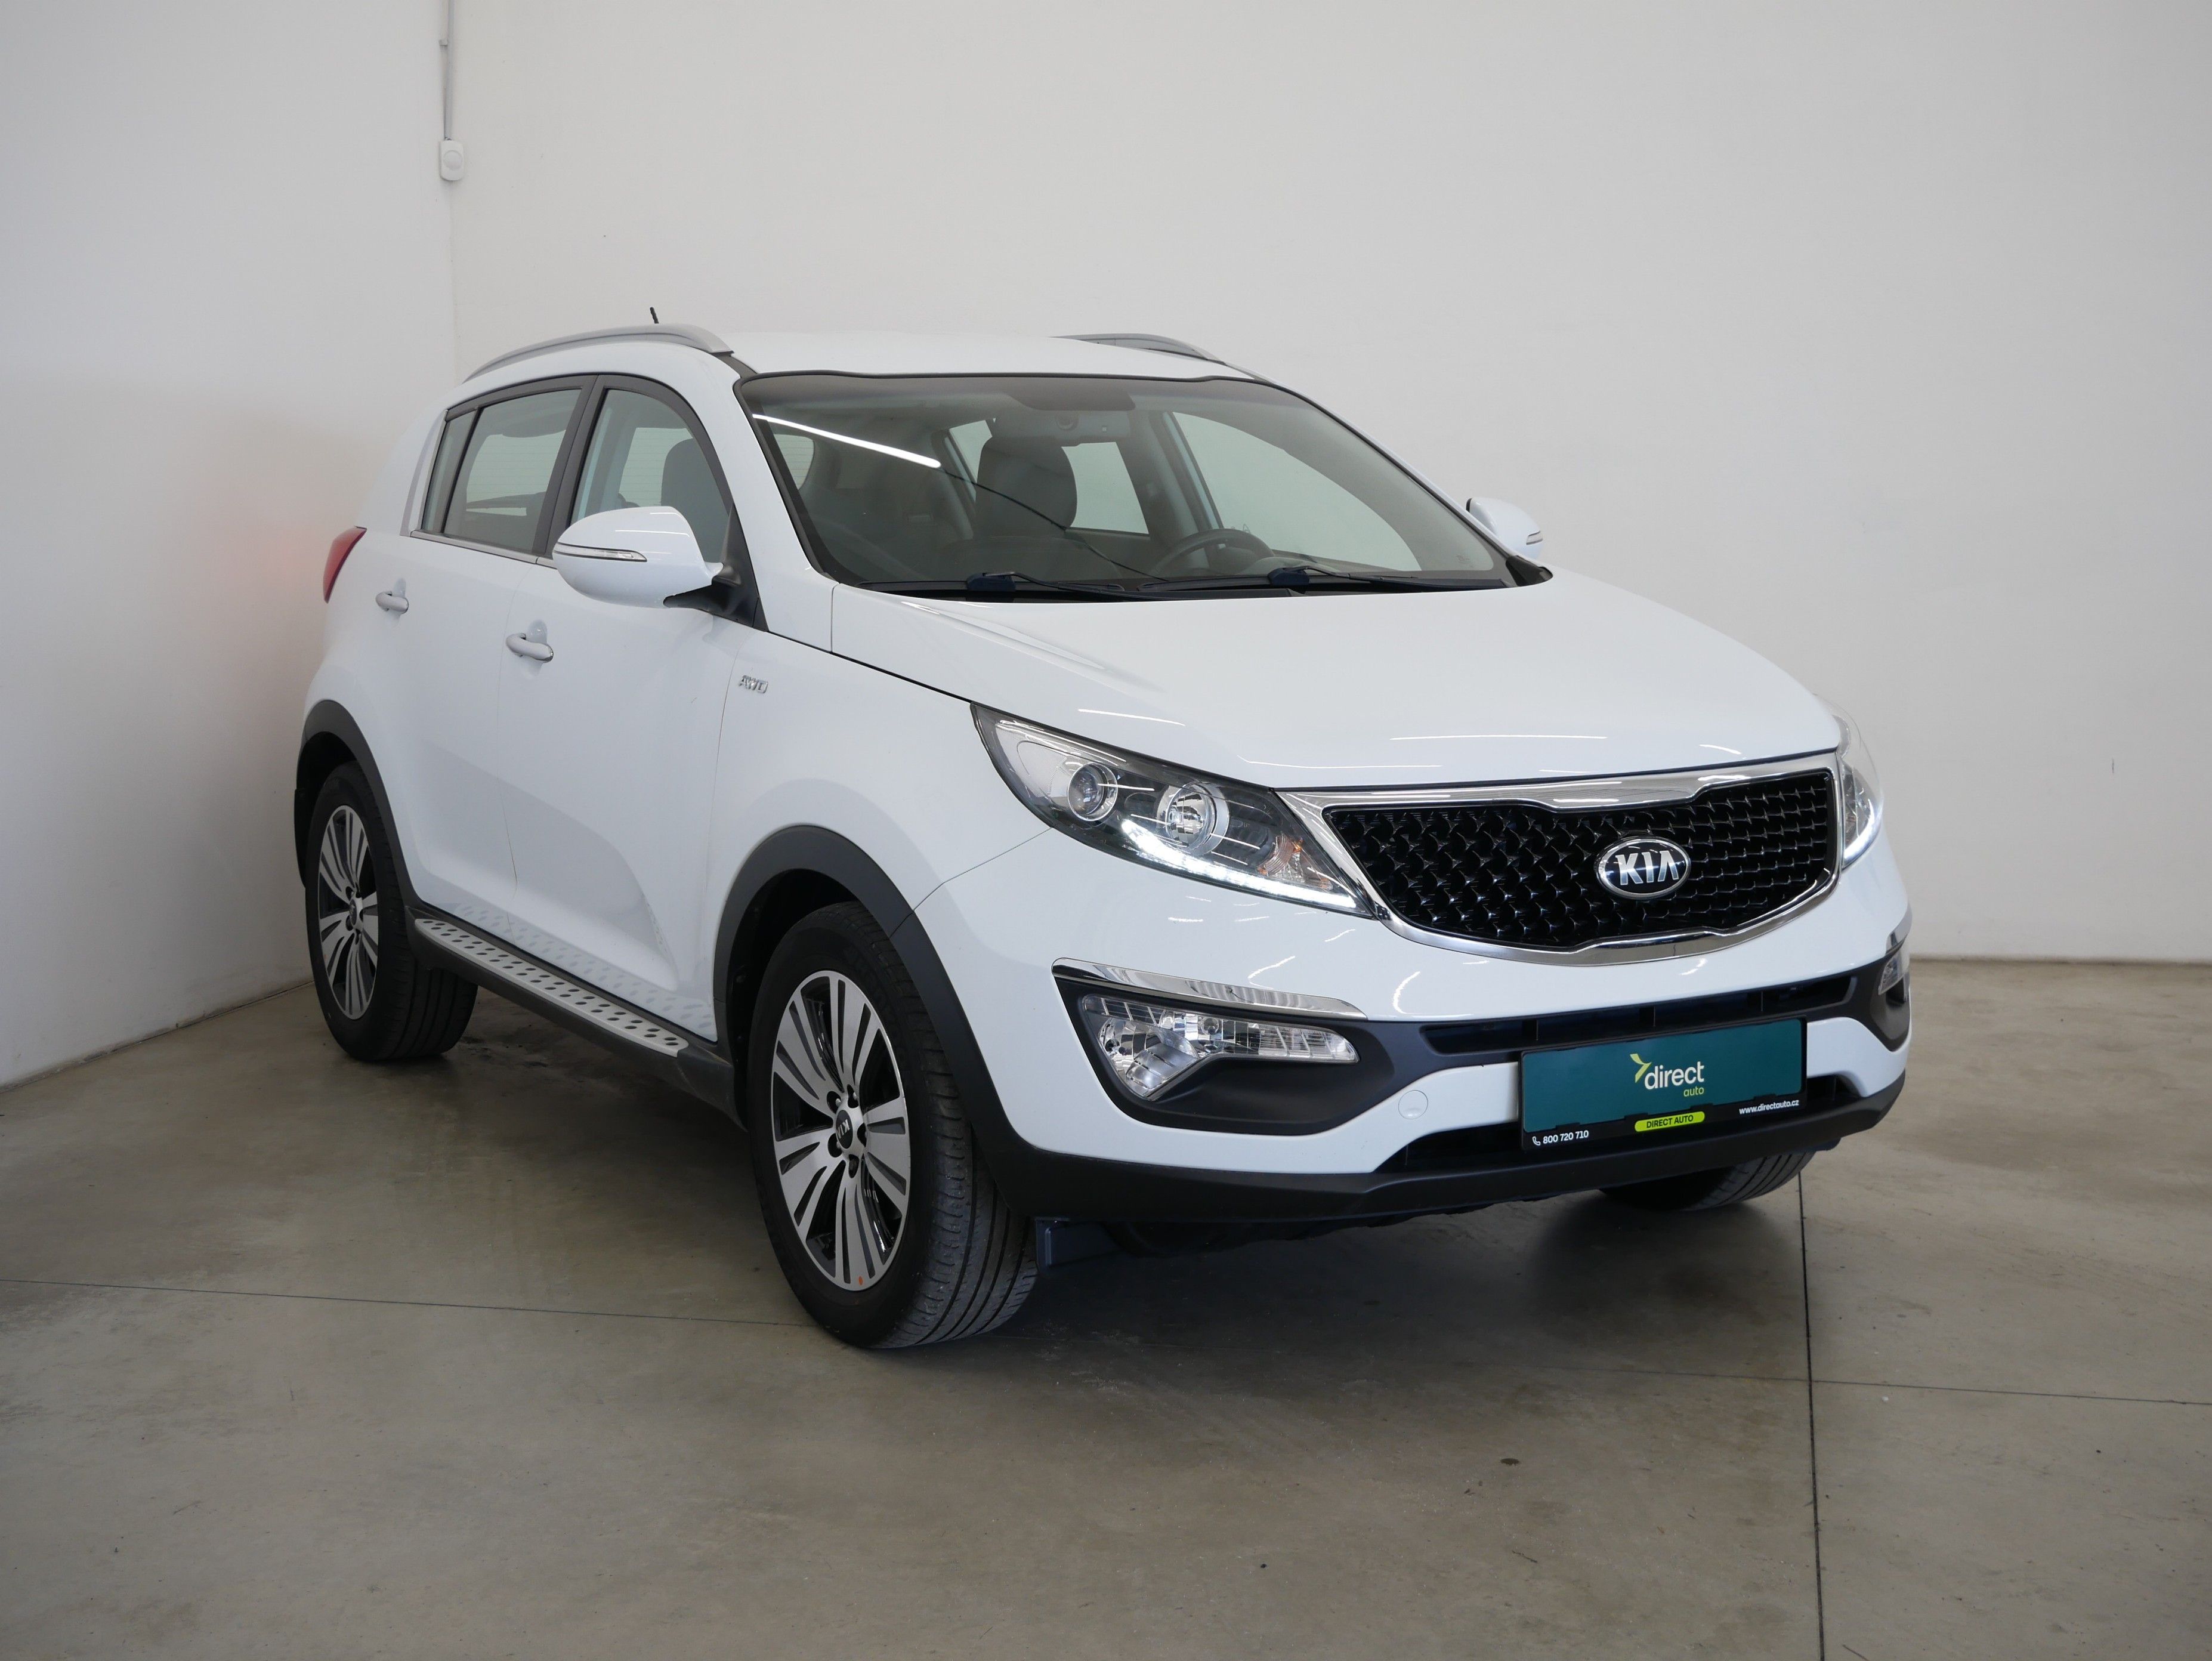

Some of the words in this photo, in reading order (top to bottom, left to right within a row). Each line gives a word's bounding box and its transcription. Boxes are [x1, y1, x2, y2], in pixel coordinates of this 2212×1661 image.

[739, 675, 768, 694] AWD
[1615, 850, 1679, 886] KIA
[1644, 1061, 1705, 1090] direct
[1683, 1086, 1704, 1097] auto
[1739, 1100, 1800, 1114] www.directauto.cz
[1646, 1117, 1672, 1128] DIRECT
[1674, 1114, 1694, 1124] AUTO
[1543, 1134, 1558, 1144] 800
[1560, 1132, 1574, 1141] 720
[1575, 1130, 1589, 1139] 710
